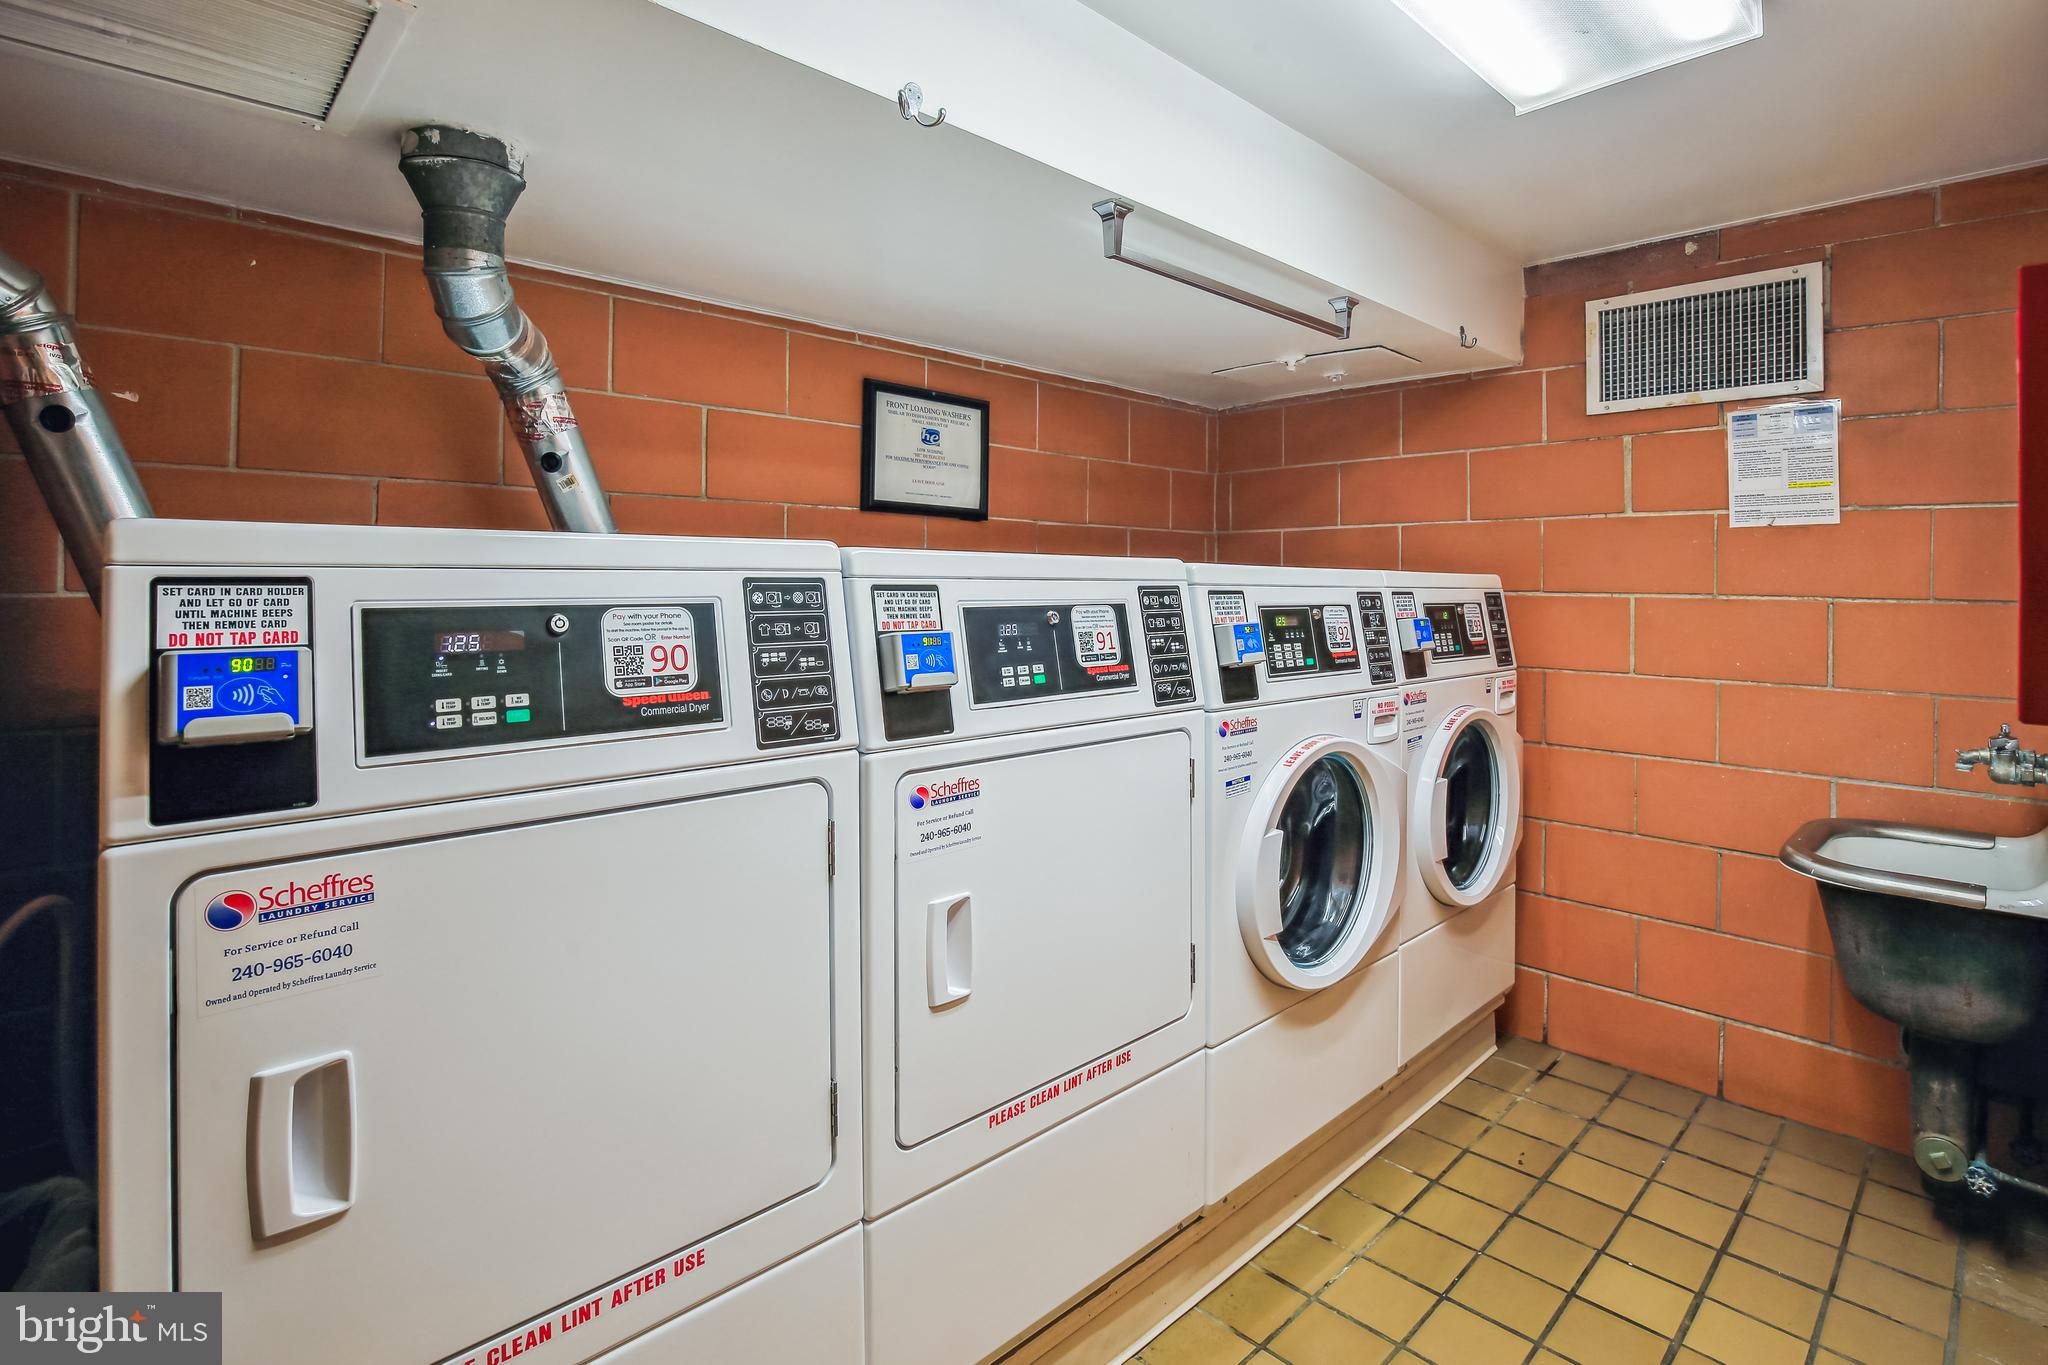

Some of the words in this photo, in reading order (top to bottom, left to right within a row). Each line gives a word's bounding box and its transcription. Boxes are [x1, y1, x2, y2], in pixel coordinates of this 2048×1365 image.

[886, 400, 909, 411] FRONT
[910, 404, 940, 415] LOADING
[942, 409, 971, 421] WASHERS
[922, 428, 939, 443] he
[162, 588, 183, 596] SET
[187, 588, 215, 596] CARD
[221, 588, 231, 596] IN
[236, 587, 263, 596] CARD
[267, 587, 304, 596] HOLDER
[179, 599, 201, 607] AND
[206, 599, 224, 607] LET
[229, 599, 242, 607] GO
[247, 599, 259, 607] OF
[263, 599, 290, 607] CARD
[175, 610, 206, 619] UNTIL
[211, 610, 257, 618] MACHINE
[262, 609, 293, 617] BEEPS
[182, 621, 210, 630] THEN
[215, 620, 256, 629] REMOVE
[261, 620, 287, 628] CARD
[882, 621, 890, 630] DO
[893, 621, 904, 629] NOT
[907, 621, 918, 629] TAP
[1473, 620, 1482, 632] 93
[169, 633, 188, 647] DO
[195, 632, 224, 646] NOT
[230, 632, 257, 645] TAP
[263, 631, 298, 644] CARD
[1096, 631, 1116, 650] 91
[1338, 626, 1350, 640] 92
[231, 658, 253, 673] 90
[650, 644, 689, 672] 90
[1096, 673, 1119, 681] Commercial
[641, 704, 687, 716] Commercial
[689, 703, 709, 713] Dryer
[1230, 716, 1257, 731] Scheffres
[1443, 717, 1458, 730] LEAVE
[1224, 750, 1252, 762] 240-965-6040
[1283, 750, 1305, 767] LEAVE
[931, 777, 980, 798] Scheffres
[926, 817, 942, 825] Service
[920, 822, 972, 843] 240-965-6040
[258, 873, 374, 911] Scheffres
[260, 904, 318, 921] LAUNDRY
[324, 893, 373, 910] SERVICE
[223, 948, 243, 957] For
[245, 938, 284, 953] Service
[286, 935, 298, 944] or
[300, 927, 337, 942] Refund
[339, 922, 359, 934] Call
[232, 943, 353, 982] 240-965-6040
[205, 994, 231, 1007] Owned
[232, 990, 247, 1001] and
[248, 983, 281, 998] Operated
[282, 981, 291, 990] by
[292, 975, 324, 987] Scheffres
[325, 967, 353, 980] Laundry
[354, 961, 377, 974] Service
[989, 1100, 1026, 1128] PLEASE
[1029, 1084, 1060, 1109] CLEAN
[1064, 1072, 1083, 1092] LINT
[1086, 1059, 1112, 1081] AFTER
[1116, 1050, 1132, 1067] USE
[486, 1321, 552, 1365] CLEAN
[561, 1297, 603, 1334] LINT
[611, 1268, 666, 1309] AFTER
[673, 1248, 705, 1278] USE
